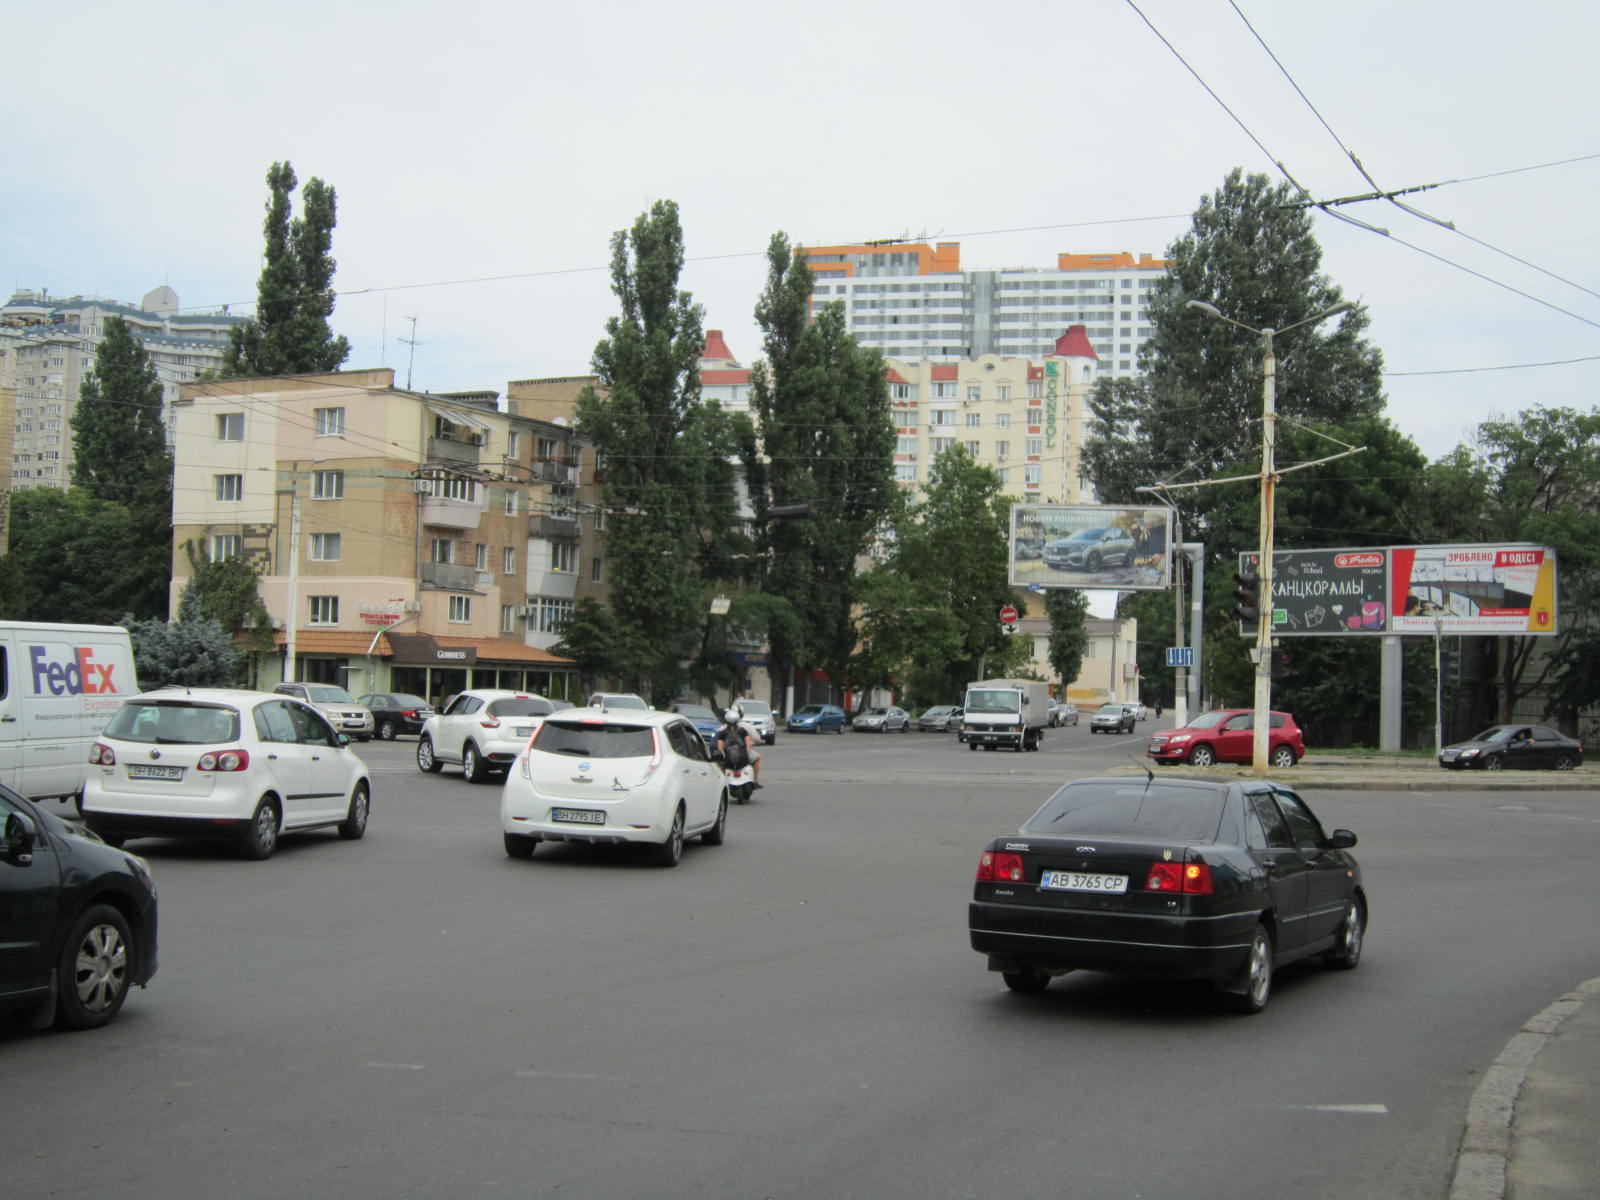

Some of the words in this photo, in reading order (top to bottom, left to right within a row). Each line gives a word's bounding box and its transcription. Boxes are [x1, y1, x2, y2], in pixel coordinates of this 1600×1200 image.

[1448, 552, 1493, 563] ЗРОБЛЕНО
[1501, 552, 1507, 563] В
[1509, 552, 1535, 563] ОДЕСІ
[437, 650, 466, 659] GUINNESS
[29, 645, 118, 695] FedEx
[1050, 873, 1069, 887] AB
[1072, 875, 1101, 889] 3765
[1104, 877, 1123, 890] CP
